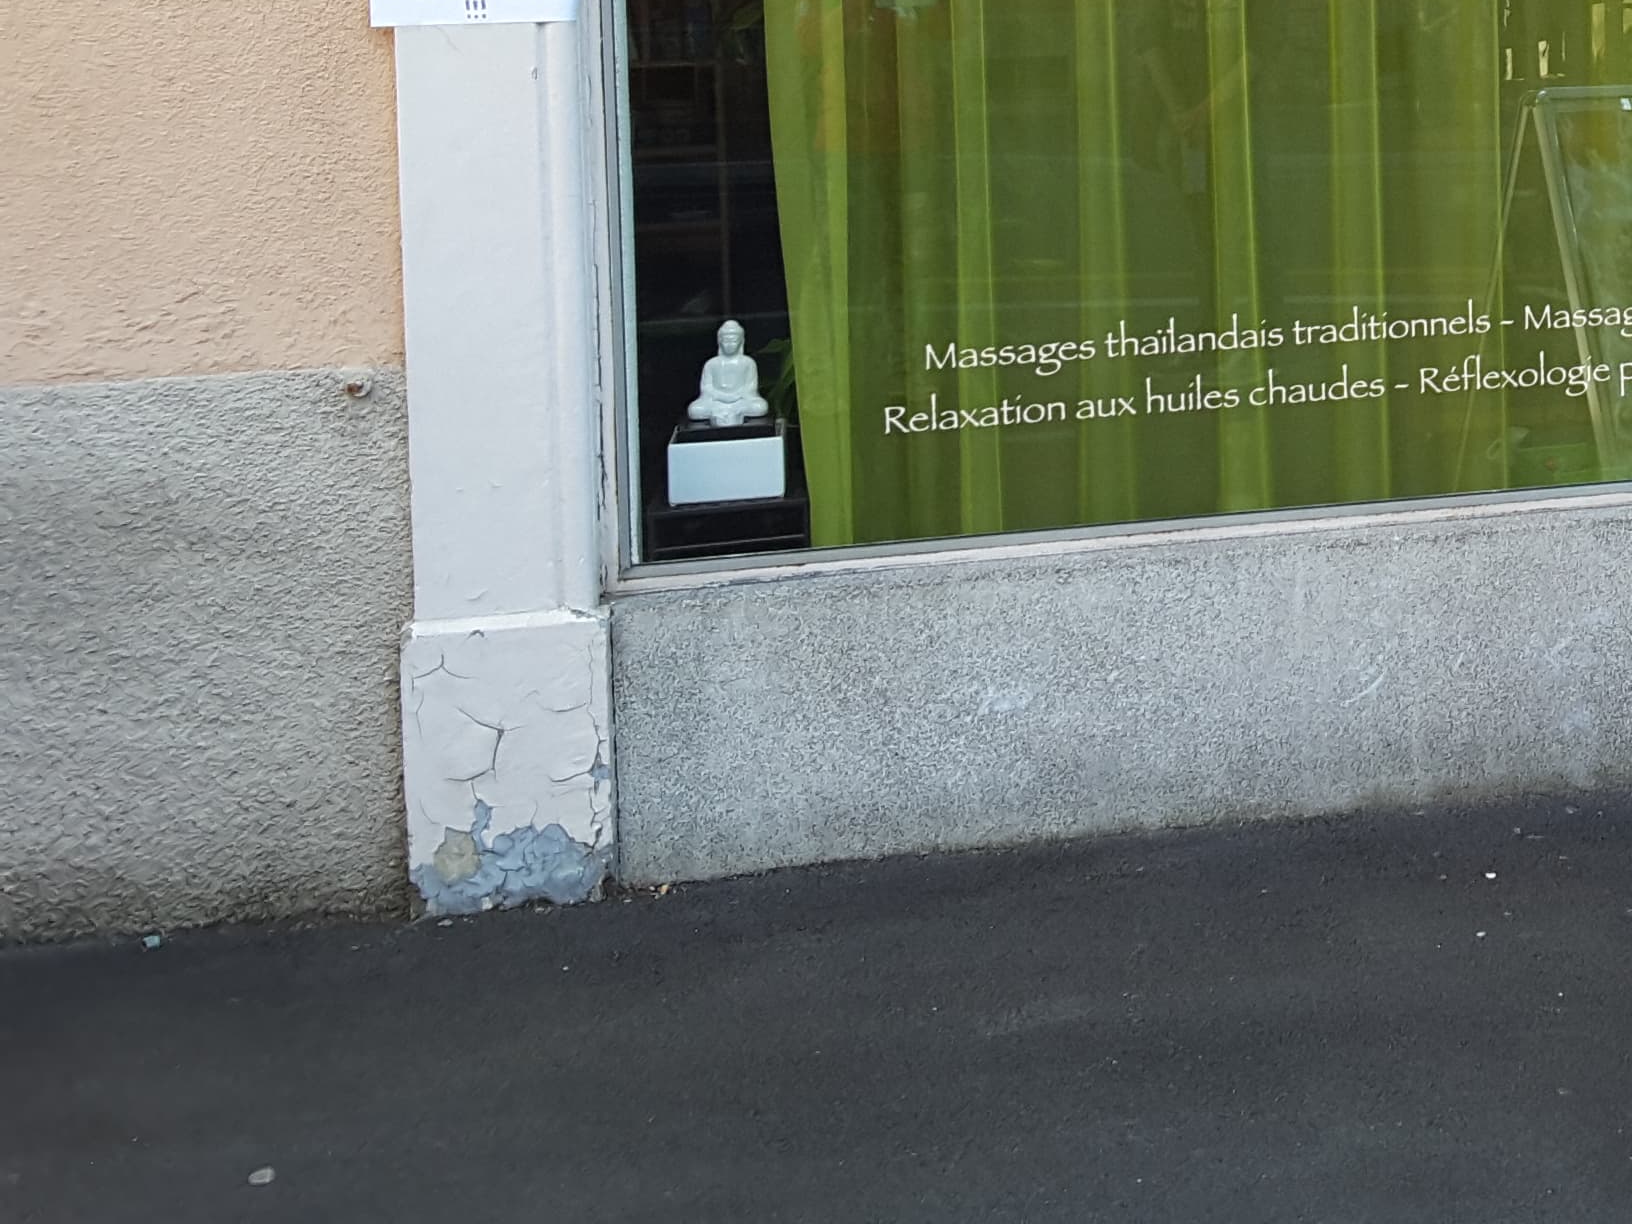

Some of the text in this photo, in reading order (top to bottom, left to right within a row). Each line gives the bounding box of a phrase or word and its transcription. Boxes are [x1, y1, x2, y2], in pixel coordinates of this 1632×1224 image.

[925, 341, 1096, 376] Massages
[1105, 313, 1284, 358] thaïlandais
[1292, 299, 1491, 345] traditionnels
[884, 393, 1066, 434] Relaxation
[1076, 396, 1137, 419] aux
[1146, 375, 1240, 414] huiles
[1249, 364, 1385, 406] chaudes
[1420, 350, 1611, 397] Réflexologie
